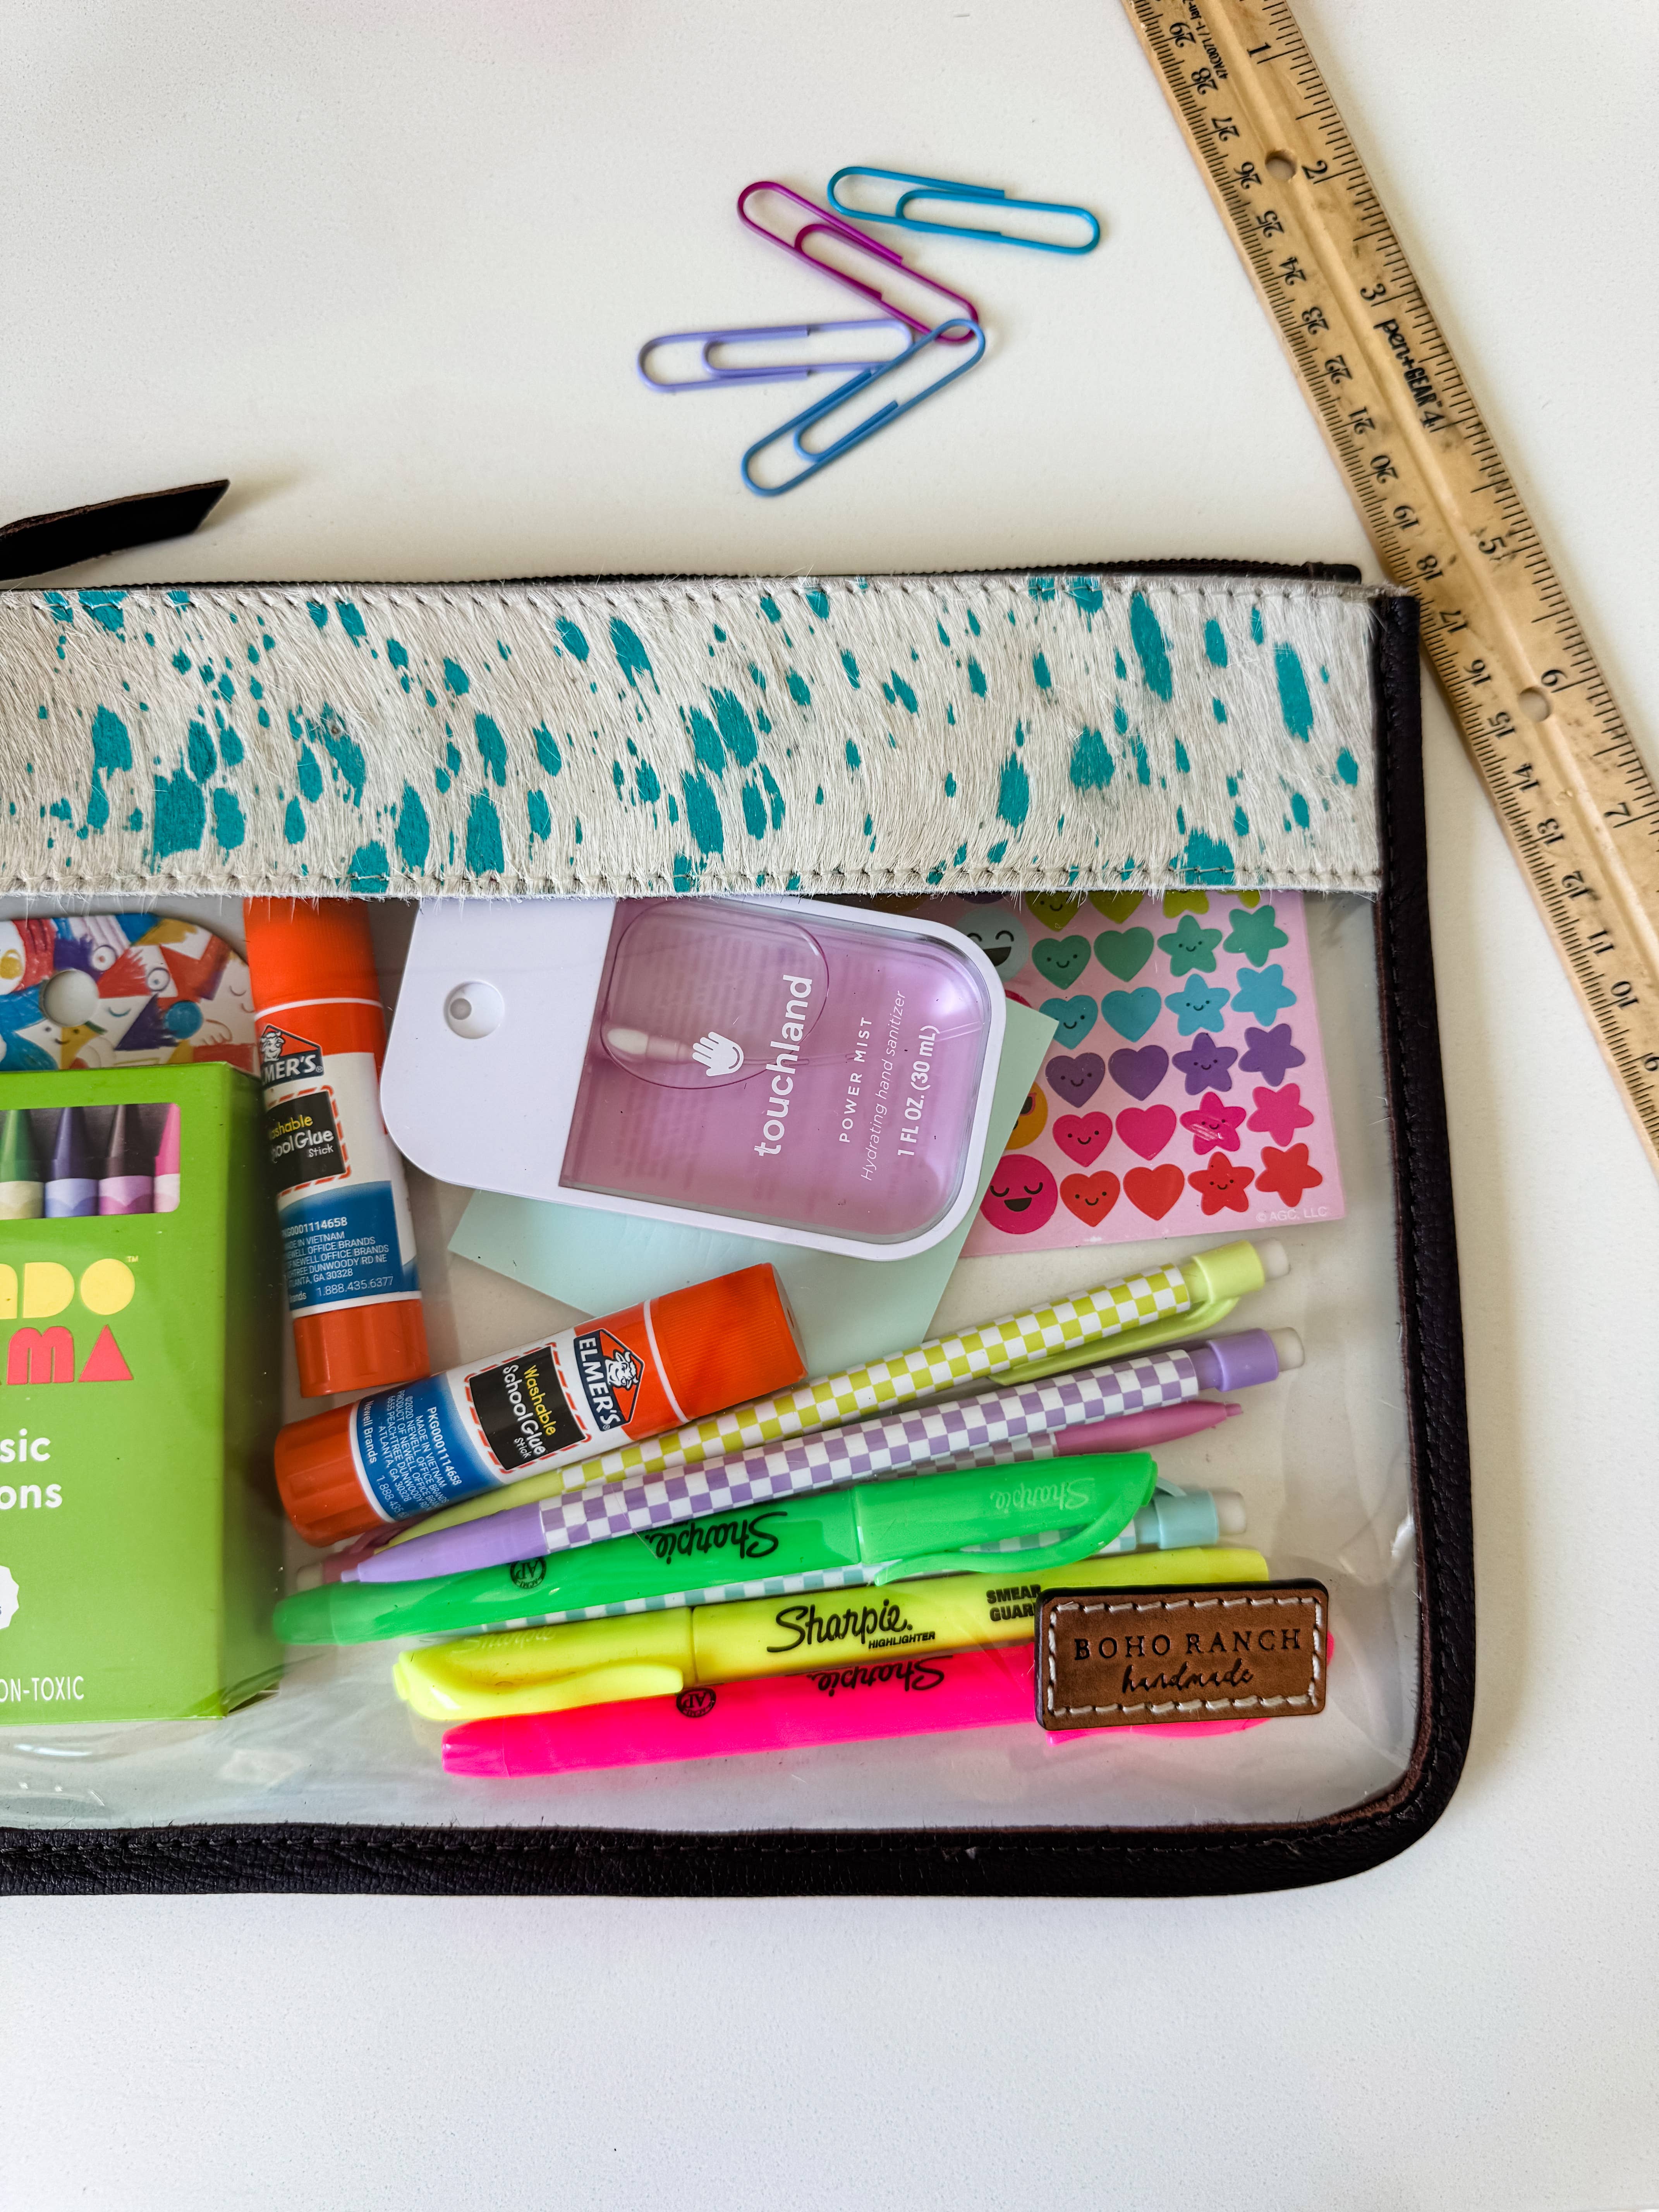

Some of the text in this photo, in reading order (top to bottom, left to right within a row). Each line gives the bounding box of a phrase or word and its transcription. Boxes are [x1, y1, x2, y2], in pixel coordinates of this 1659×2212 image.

[1247, 41, 1632, 818] 1 2 3 4 5 6 7
[1169, 22, 1197, 48] 29
[1191, 67, 1218, 95] 28
[1211, 117, 1240, 142] 27
[1234, 161, 1262, 189] 26
[1258, 210, 1285, 238] 25
[1280, 256, 1307, 286] 24
[1301, 306, 1330, 335] 23
[1324, 355, 1353, 385] 22
[1348, 406, 1376, 435] 21
[1370, 455, 1399, 484] 20
[1393, 505, 1420, 531] 19
[1416, 554, 1444, 582] 18
[1439, 609, 1469, 635] 17
[1463, 659, 1492, 687] 16
[1486, 711, 1516, 740] 15
[1513, 763, 1541, 793] 14
[1536, 817, 1566, 847] 13
[1561, 871, 1590, 900] 12
[1587, 929, 1615, 956] 11
[1609, 980, 1640, 1010] 10
[919, 1025, 940, 1057] mL)
[754, 975, 813, 1156] touchland
[911, 1061, 931, 1090] (30
[839, 1017, 872, 1143] POWER MIST
[861, 990, 905, 1181] Hydrating hand sanitizer
[904, 1094, 924, 1120] OZ.
[270, 1115, 313, 1139] ashable
[900, 1126, 919, 1143] FL
[308, 1144, 333, 1158] Stick
[1304, 1206, 1327, 1218] LLC
[306, 1231, 345, 1245] VIETNAM
[308, 1242, 336, 1254] OFFICE
[339, 1237, 375, 1249] BRANDS
[309, 1259, 359, 1274] DUNWOODY
[362, 1256, 374, 1264] RD
[376, 1254, 387, 1262] NE
[321, 1249, 352, 1261] OFFICE
[354, 1245, 389, 1256] BRANDS
[314, 1273, 325, 1282] GA
[327, 1269, 353, 1279] 30328
[316, 1276, 393, 1297] 1.888.435.6377
[363, 1400, 374, 1426] Newell
[387, 1395, 395, 1411] 6655
[396, 1389, 405, 1421] PRODUCT
[524, 1365, 556, 1436] Washable
[387, 1411, 404, 1462] PEACHTREE
[398, 1423, 407, 1435] OF
[364, 1427, 378, 1464] Brands
[400, 1436, 416, 1472] NEWELL
[407, 1420, 419, 1456] NEWELL
[416, 1456, 434, 1484] OFFICE
[416, 1415, 447, 1488] MADE IN VIETNAM
[428, 1407, 462, 1486] PKG0001114658
[514, 1437, 532, 1459] Stick
[378, 1426, 412, 1502] ATLANTA, GA 30328
[397, 1462, 424, 1502] DUNWOODY
[412, 1472, 431, 1496] OFFICE
[986, 1584, 1041, 1604] SMEAR
[990, 1602, 1036, 1621] GUAR
[869, 1631, 935, 1649] HIGHLIGHTER
[1073, 1628, 1302, 1661] BOHO RANCH
[1122, 1658, 1254, 1694] handmade
